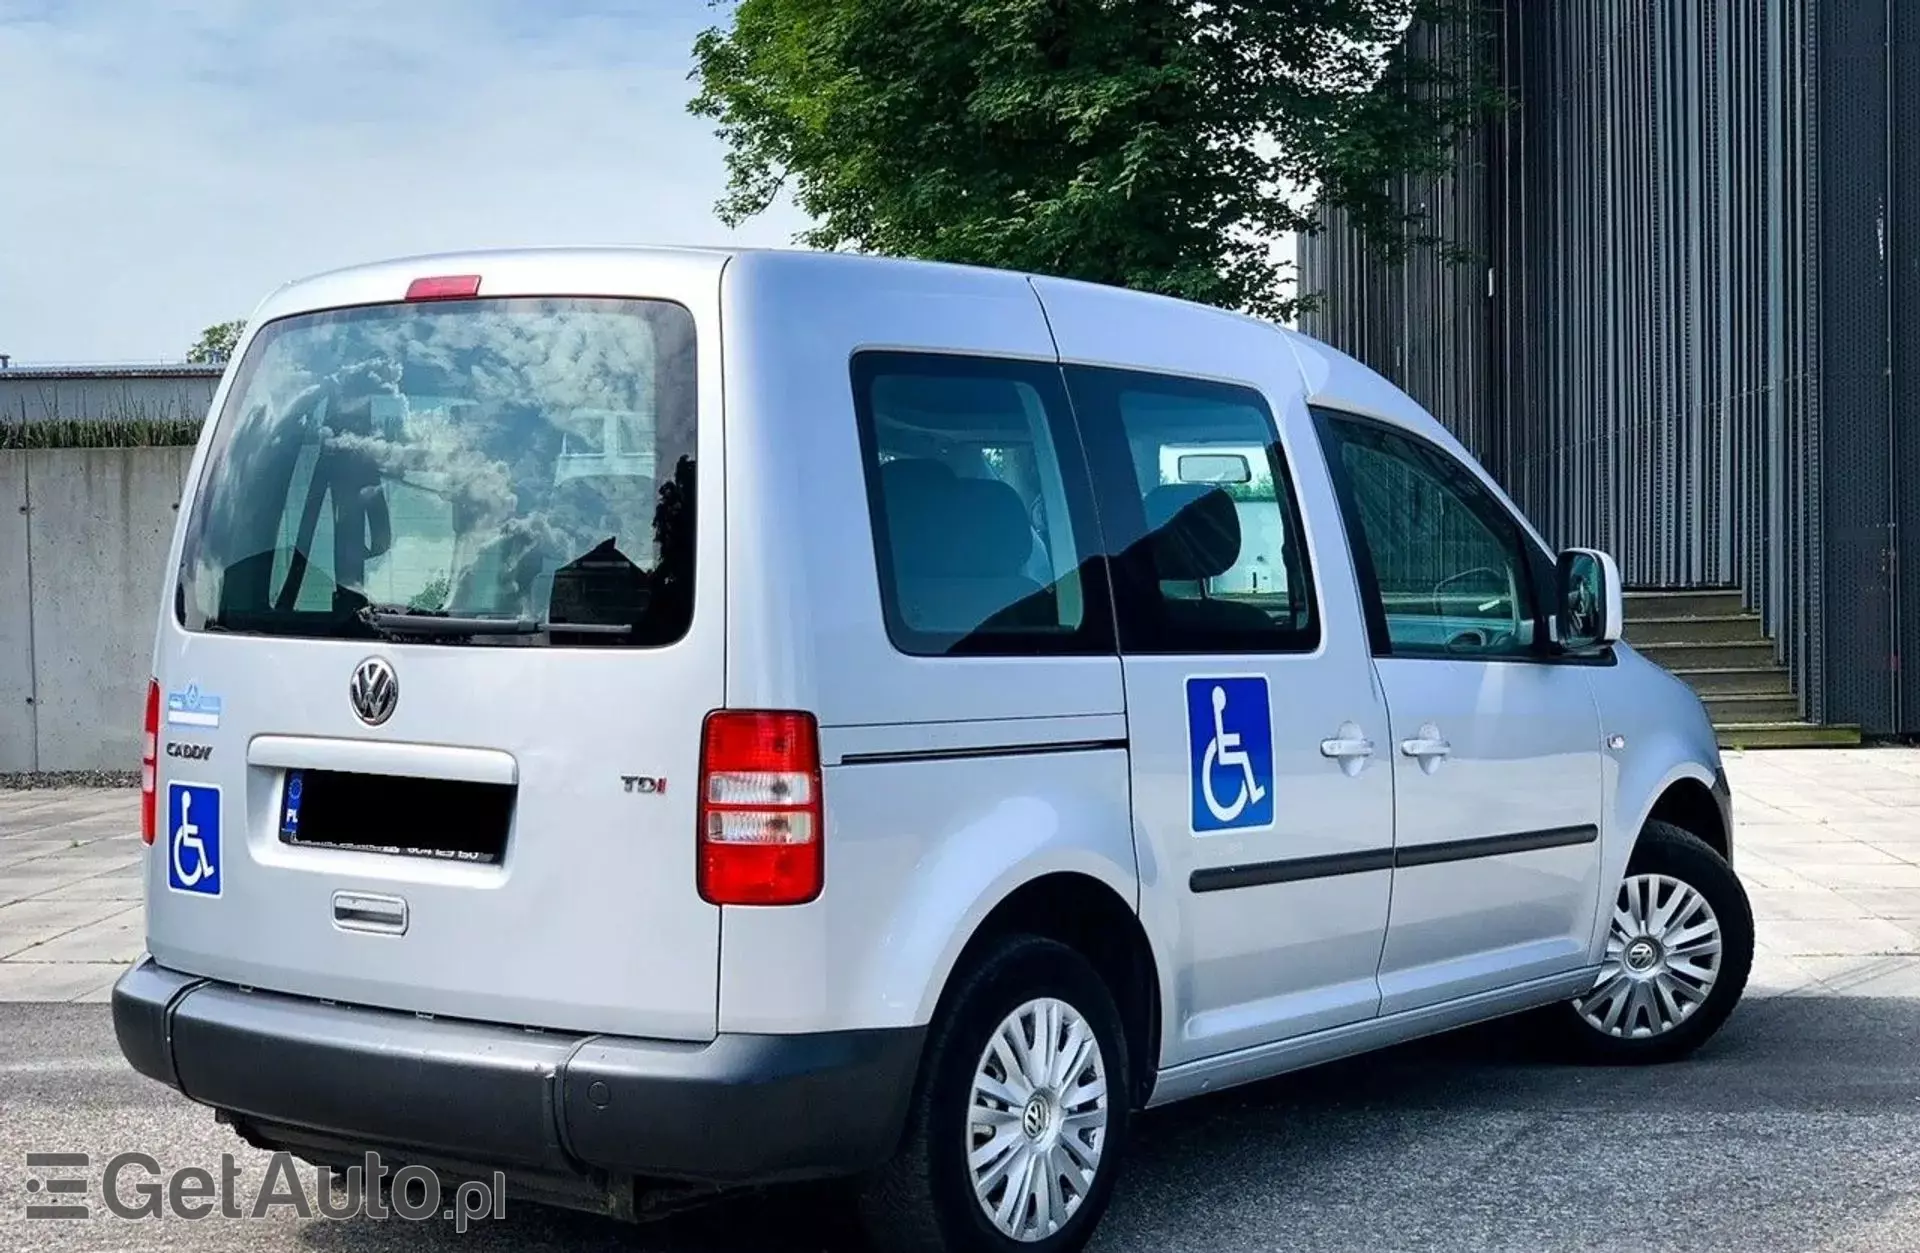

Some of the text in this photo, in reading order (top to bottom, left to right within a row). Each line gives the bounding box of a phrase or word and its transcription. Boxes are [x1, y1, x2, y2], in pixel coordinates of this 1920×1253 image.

[351, 656, 398, 726] VW
[166, 742, 213, 761] CADDY
[621, 775, 667, 794] TDI
[286, 808, 299, 824] PL
